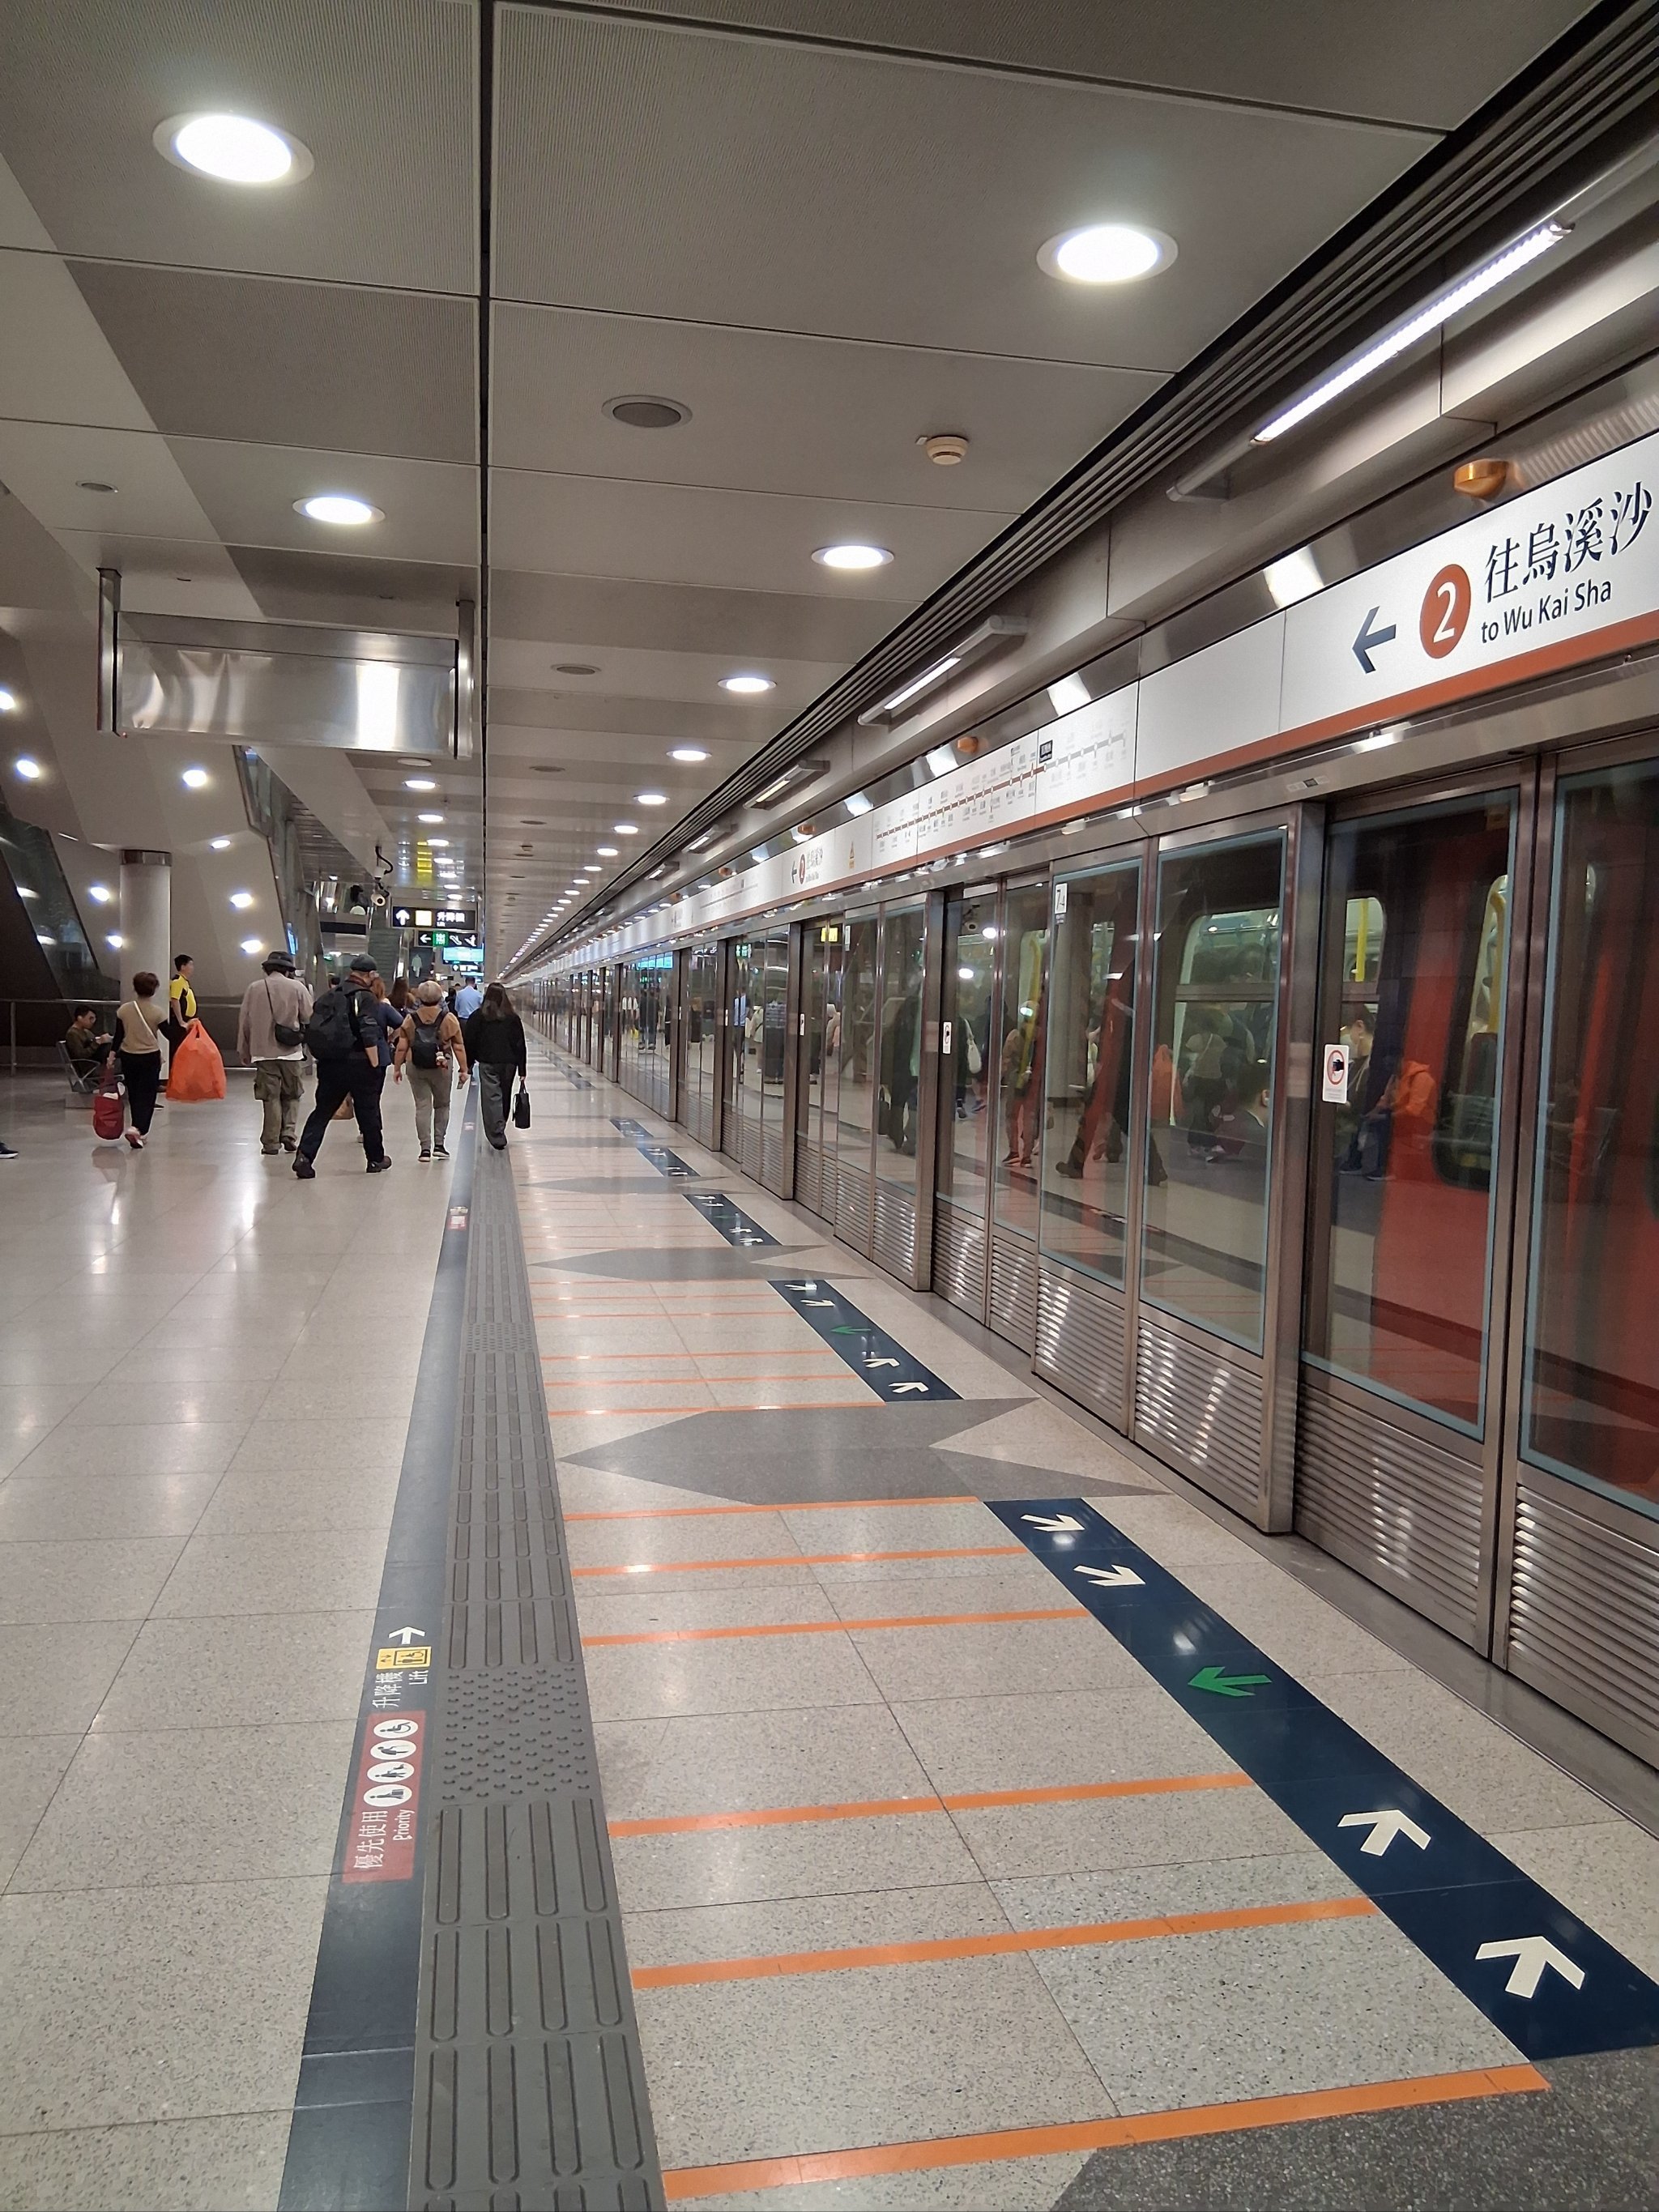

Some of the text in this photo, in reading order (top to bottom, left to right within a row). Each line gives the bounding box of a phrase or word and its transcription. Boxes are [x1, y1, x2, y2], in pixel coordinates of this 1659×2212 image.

[1484, 481, 1653, 603] 往烏溪沙
[1433, 582, 1456, 643] 2
[1482, 578, 1612, 643] to Wu Kai Sha
[372, 1671, 403, 1708] 升降機
[408, 1670, 429, 1685] Lift
[353, 1810, 389, 1869] 優先使用
[392, 1809, 416, 1841] Priority
